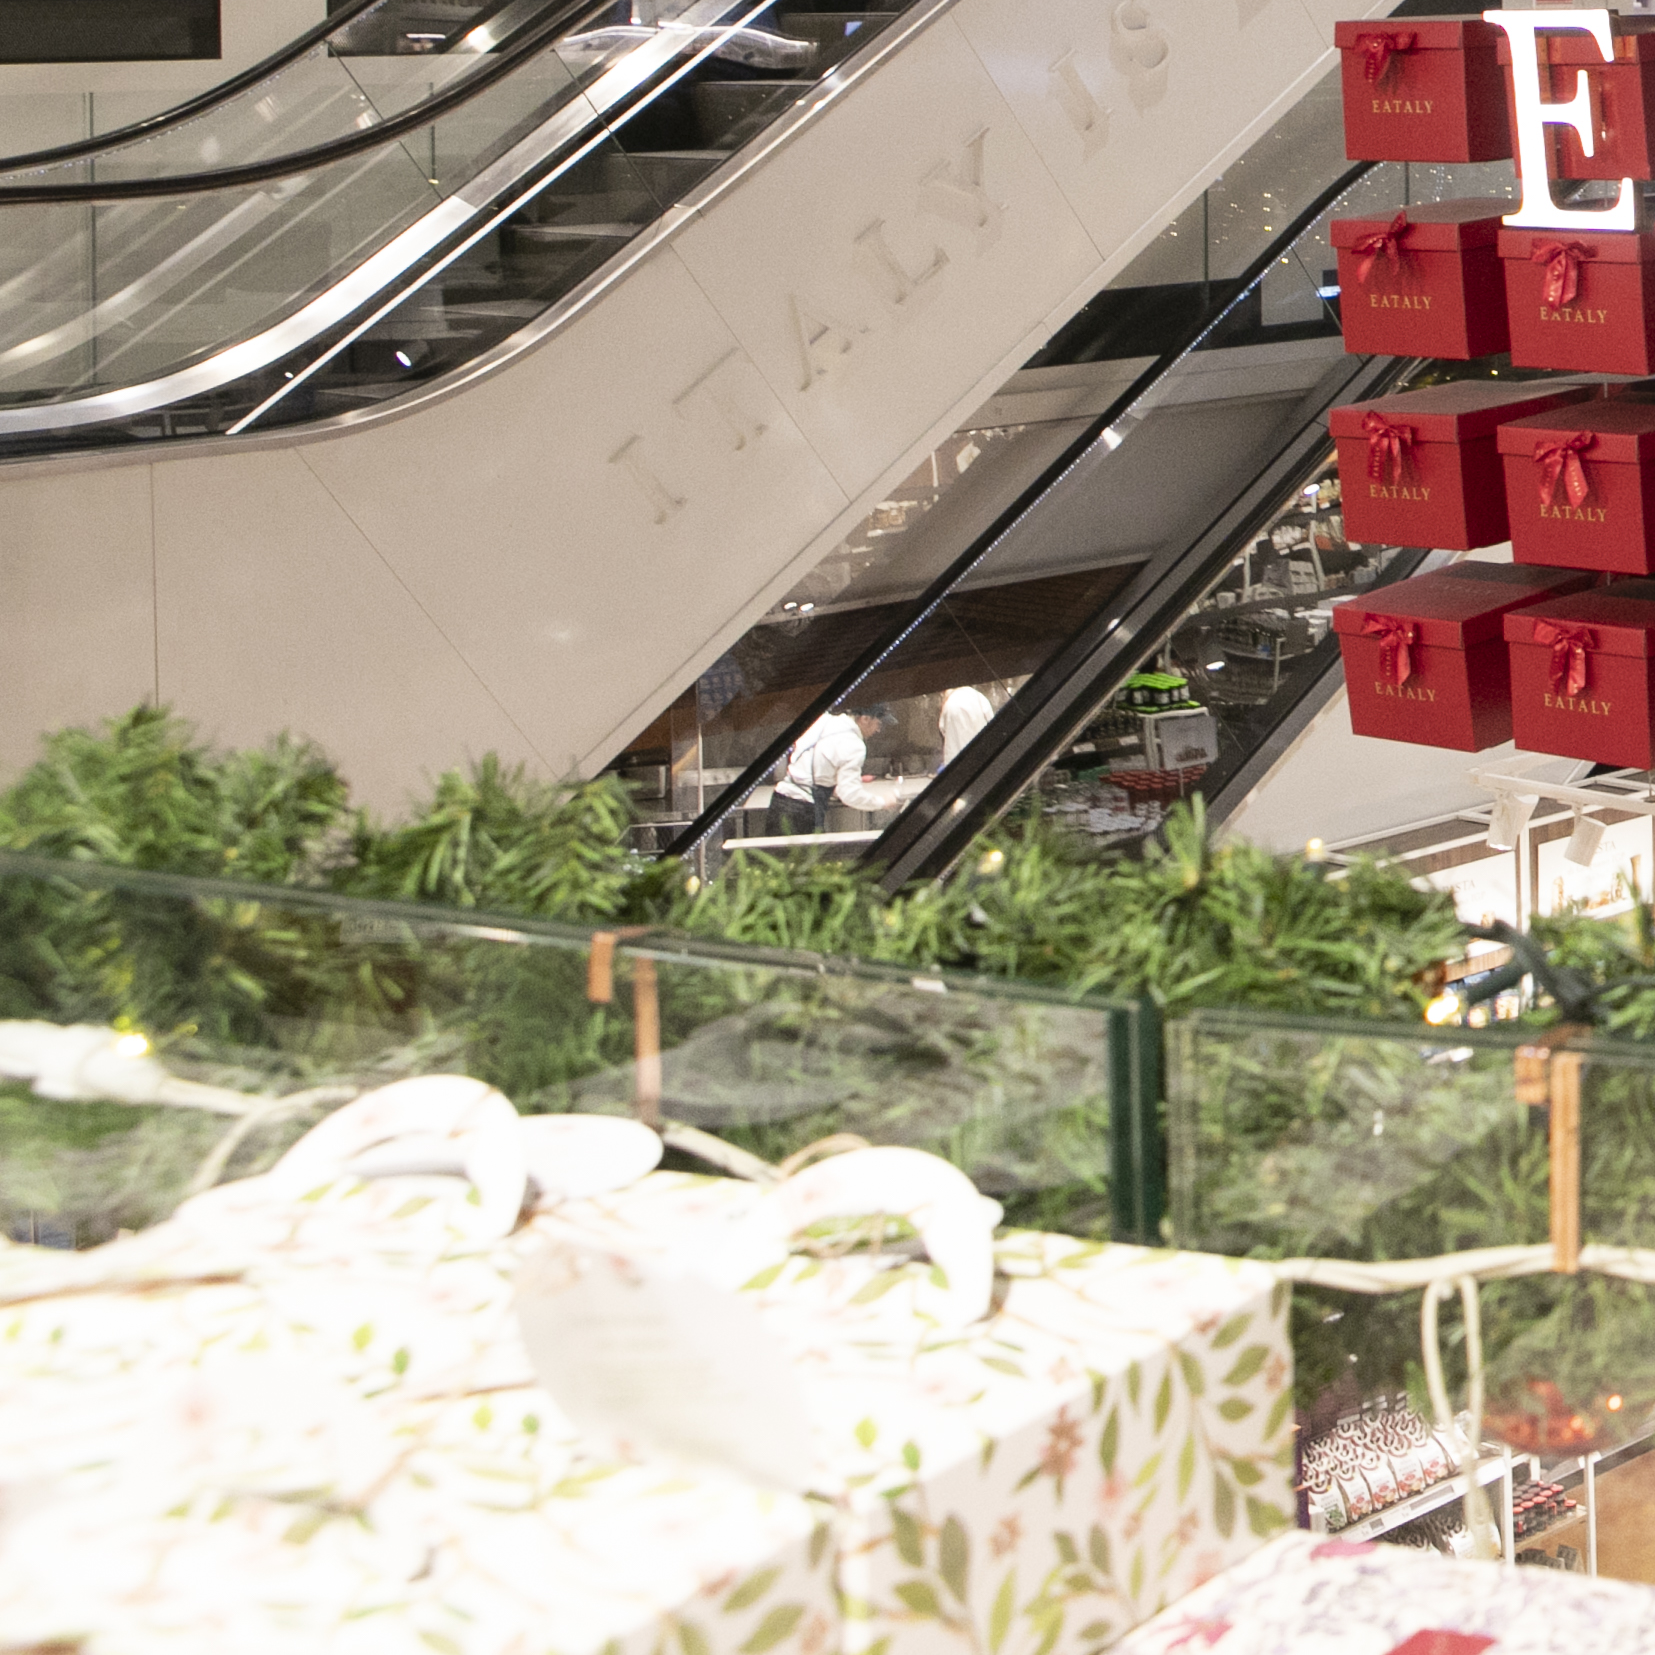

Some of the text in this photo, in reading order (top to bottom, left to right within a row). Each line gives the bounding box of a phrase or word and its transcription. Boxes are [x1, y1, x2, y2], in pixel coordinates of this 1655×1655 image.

[1372, 99, 1434, 114] EATALY
[1370, 294, 1433, 310] EATALY
[1539, 306, 1609, 324] EATALY
[1369, 484, 1432, 501] EATALY
[1539, 503, 1607, 523] EATALY
[1374, 681, 1437, 702] EATALY
[1543, 693, 1612, 716] EATALY
